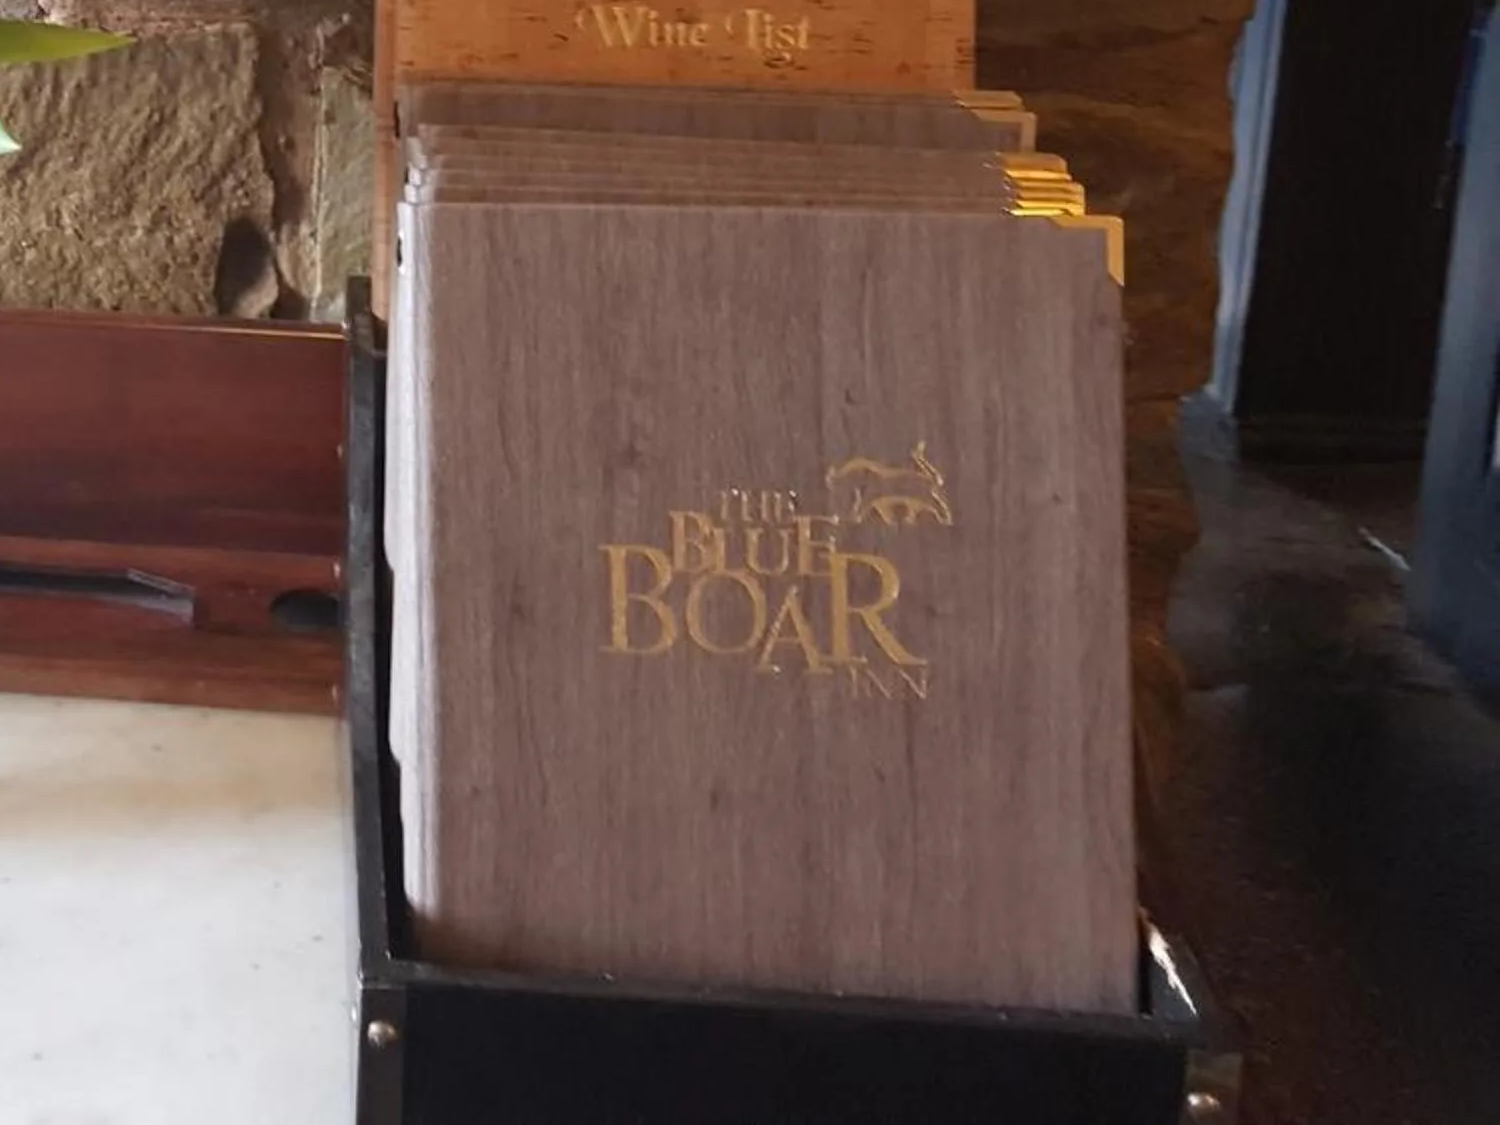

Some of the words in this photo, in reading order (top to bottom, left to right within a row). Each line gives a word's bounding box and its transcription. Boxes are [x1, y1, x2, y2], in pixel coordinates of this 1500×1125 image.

[574, 4, 710, 48] Wine
[669, 510, 839, 575] BLUE
[599, 543, 929, 674] BOAR
